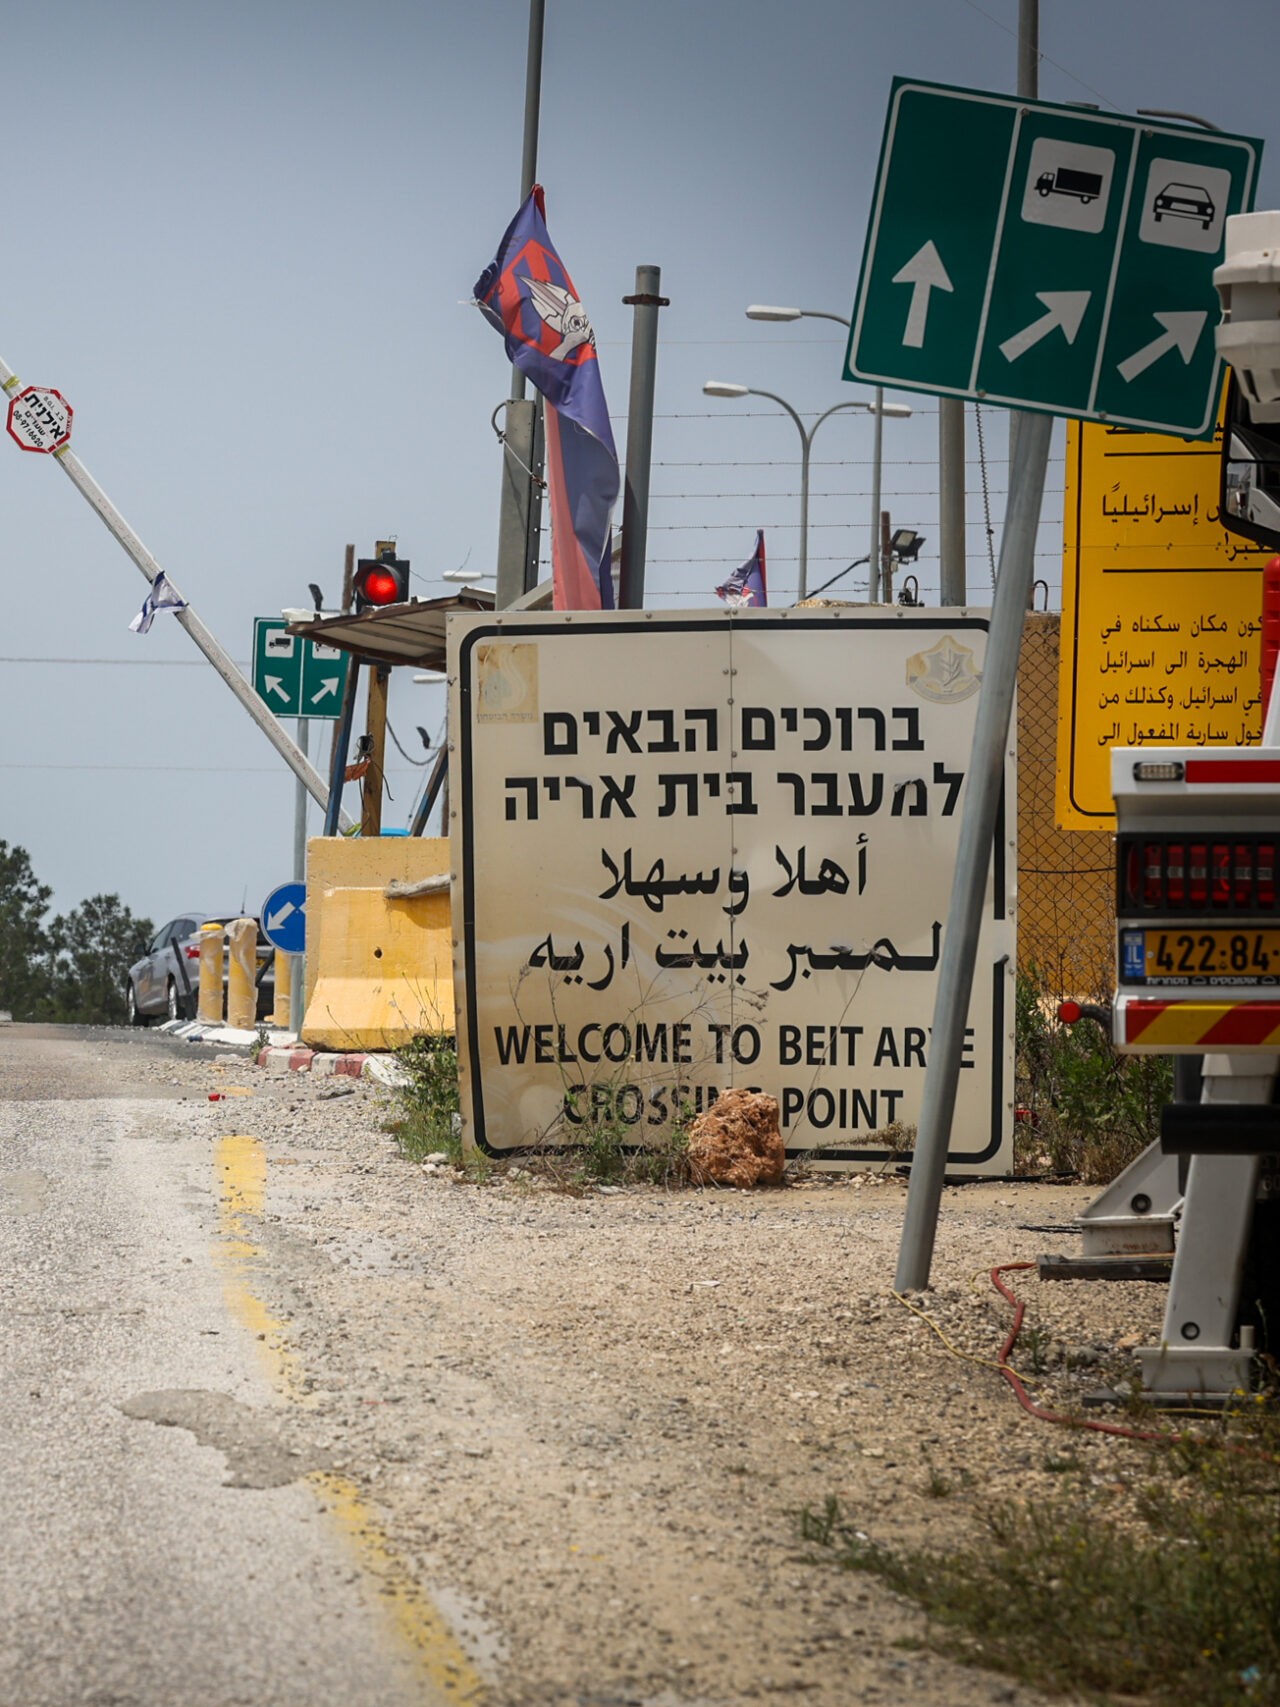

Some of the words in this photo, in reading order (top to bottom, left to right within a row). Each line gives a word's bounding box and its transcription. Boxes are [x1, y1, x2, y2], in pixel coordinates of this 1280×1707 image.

[24, 393, 65, 440] אילנית
[1101, 614, 1122, 644] في
[1132, 614, 1180, 632] سكناه
[1191, 614, 1228, 637] مكان
[1100, 651, 1155, 674] اسرائيل
[1165, 651, 1188, 674] الى
[1198, 651, 1248, 674] الهجرة
[1099, 693, 1120, 709] من
[1125, 686, 1174, 709] وكذلك
[543, 708, 718, 755] הבאים
[741, 706, 925, 752] ברוכים
[1127, 723, 1179, 745] المفعول
[504, 774, 636, 821] אריה
[658, 771, 759, 817] בית
[777, 762, 965, 817] למעבר
[598, 847, 749, 916] وسهلا
[772, 833, 869, 898] أهلا
[655, 928, 750, 986] بيت
[769, 921, 943, 992] لمعبر
[1127, 945, 1141, 963] IL
[494, 1023, 696, 1066] WELCOME
[707, 1024, 762, 1066] TO
[779, 1025, 864, 1067] BEIT
[872, 1026, 975, 1069] ARE
[782, 1087, 904, 1130] POINT
